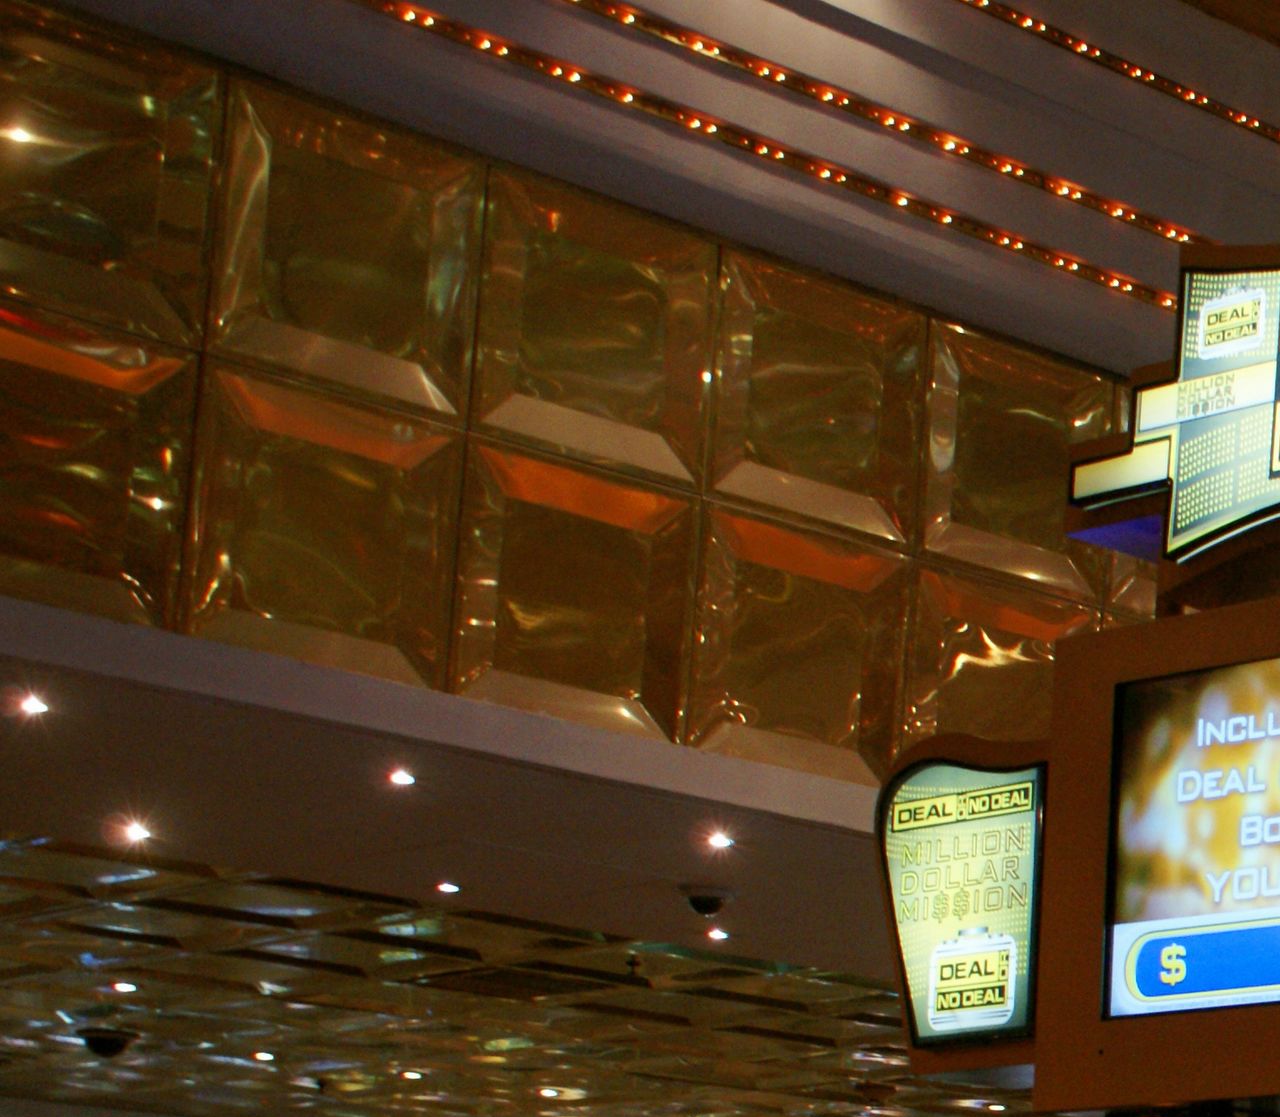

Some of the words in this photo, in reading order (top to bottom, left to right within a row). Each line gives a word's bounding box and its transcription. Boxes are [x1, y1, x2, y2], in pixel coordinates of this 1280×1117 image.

[1206, 305, 1251, 328] DEAL
[1205, 329, 1224, 347] NO
[1224, 321, 1258, 343] DEAL
[1177, 373, 1236, 395] MILLION
[1177, 386, 1233, 407] DOLLAR
[1176, 768, 1266, 803] DEAL
[898, 802, 953, 825] DEAL
[969, 794, 989, 814] NO
[991, 788, 1029, 809] DEAL
[901, 826, 1026, 869] MILLION
[900, 856, 1021, 897] DOLLAR
[939, 959, 995, 982] DEAL
[1159, 942, 1188, 987] $
[937, 990, 960, 1011] NO
[962, 984, 1005, 1008] DEAL
